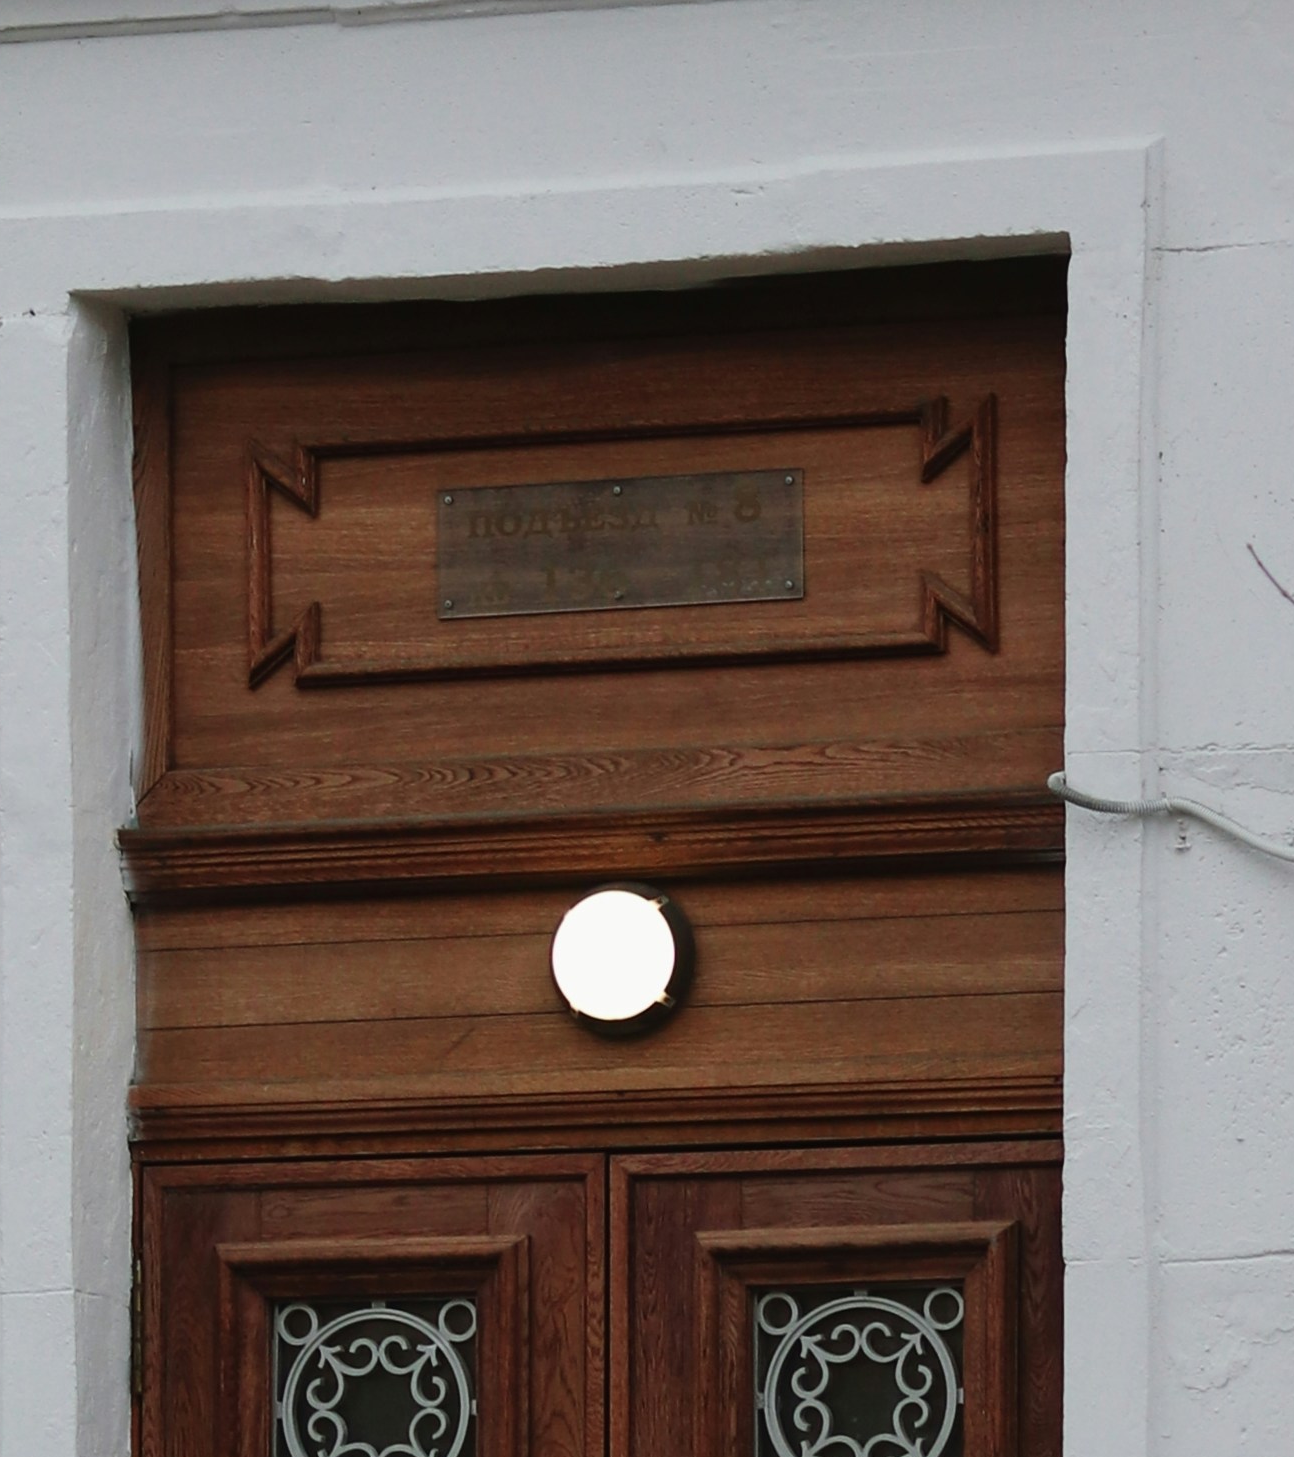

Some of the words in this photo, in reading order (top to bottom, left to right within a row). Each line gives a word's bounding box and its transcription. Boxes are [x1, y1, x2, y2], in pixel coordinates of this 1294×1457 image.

[466, 506, 659, 539] ПОДЪЕЗД
[686, 500, 719, 526] №
[733, 484, 762, 523] 8
